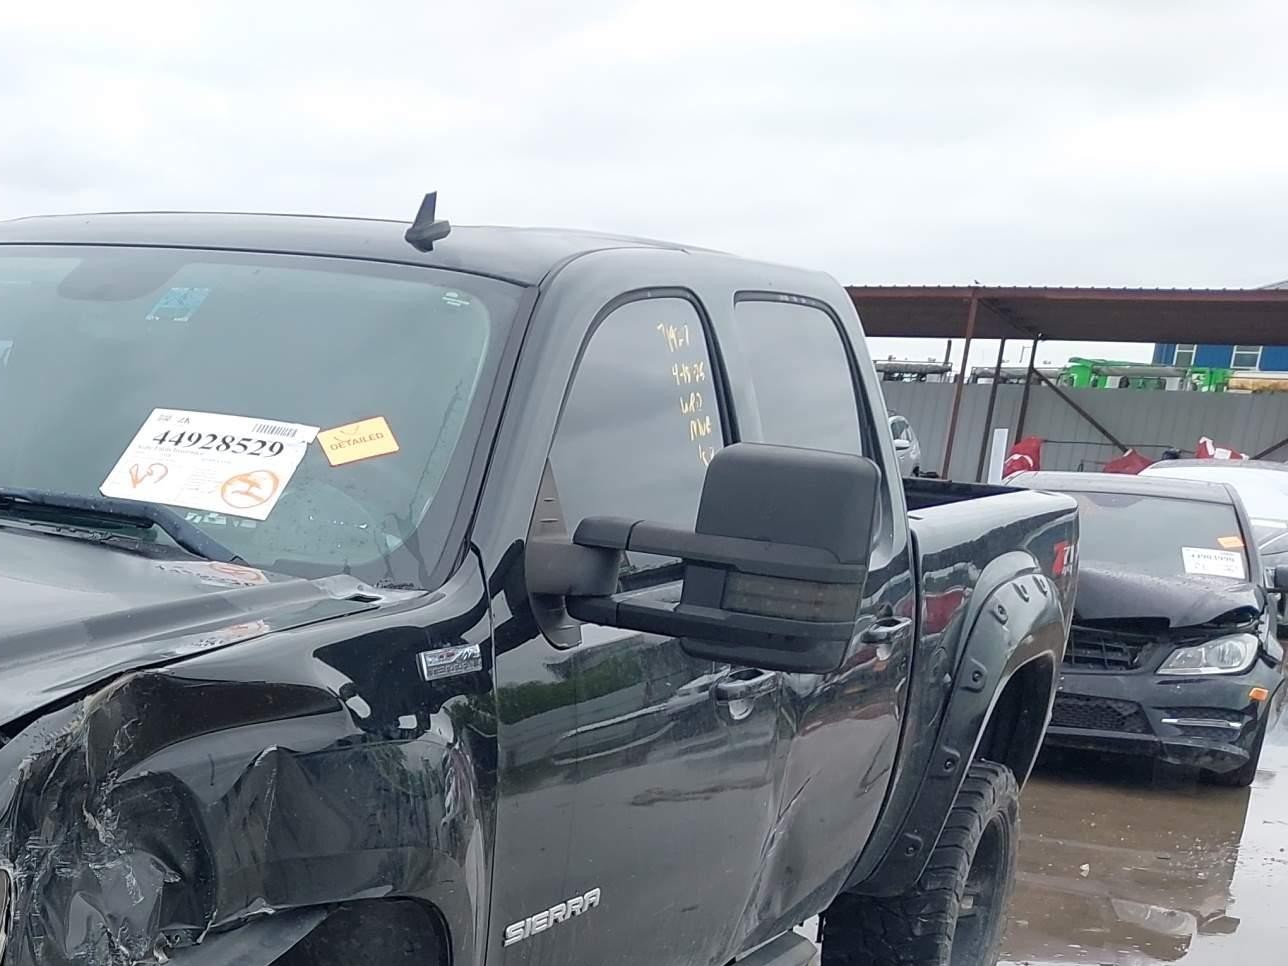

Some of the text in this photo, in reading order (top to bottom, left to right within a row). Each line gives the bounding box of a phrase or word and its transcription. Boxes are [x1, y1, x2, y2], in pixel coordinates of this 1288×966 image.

[153, 430, 284, 458] 44928529
[330, 432, 384, 451] DETAILED
[503, 887, 601, 948] SIERRA
